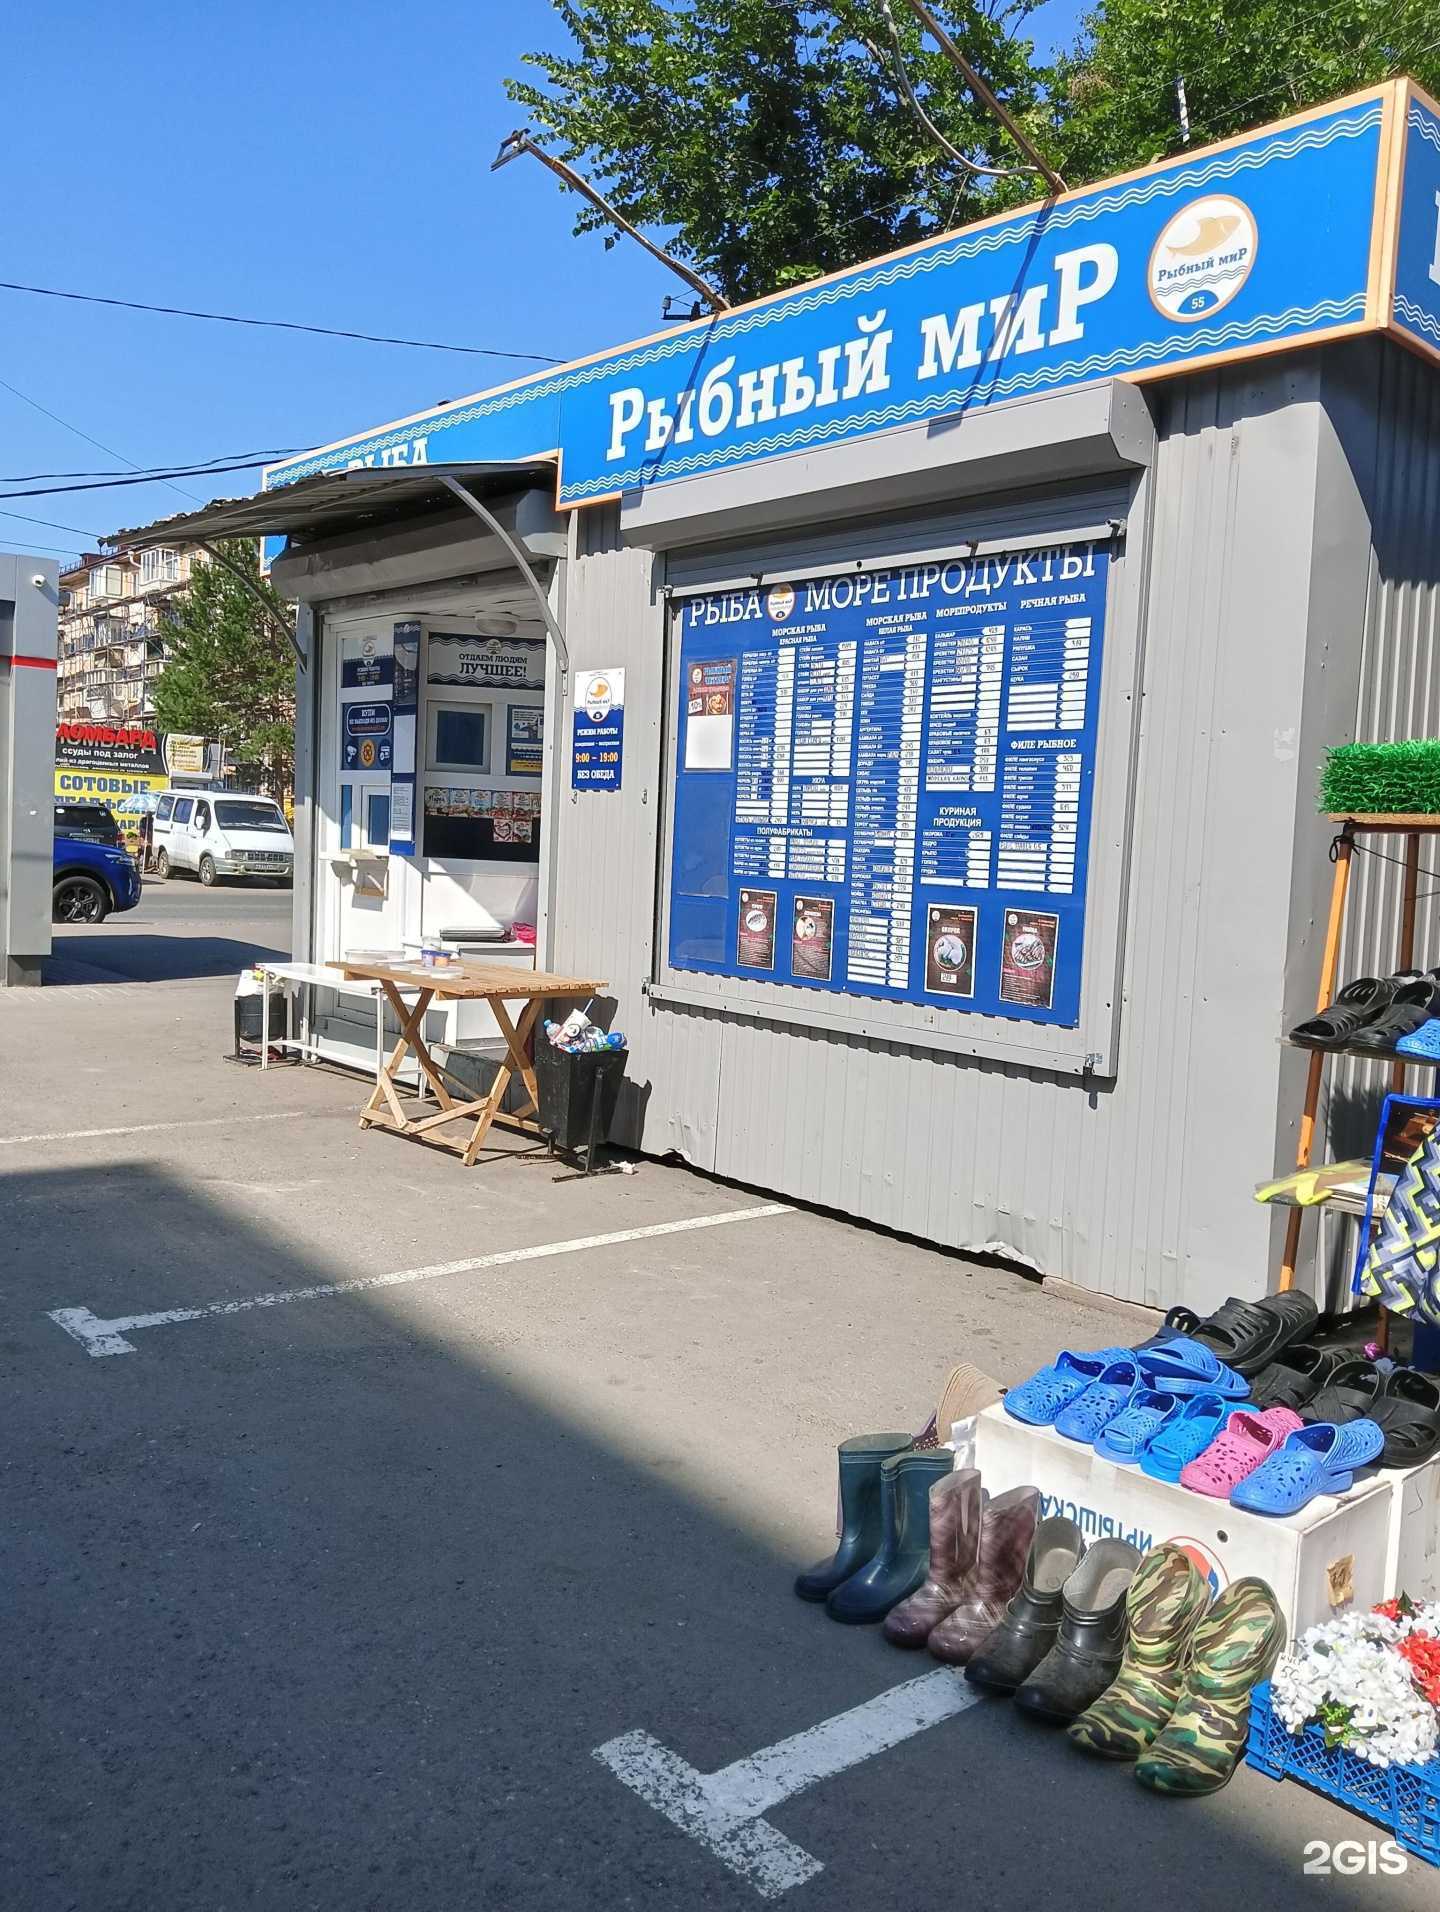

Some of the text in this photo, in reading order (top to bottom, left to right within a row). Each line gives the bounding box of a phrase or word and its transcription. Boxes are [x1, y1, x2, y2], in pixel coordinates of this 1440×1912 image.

[1158, 256, 1215, 282] Рыбный
[1191, 296, 1205, 310] 55
[606, 242, 1119, 462] Рыбный миР
[689, 544, 1096, 627] РЫБА МОРЕ ПРОДУКТЫ
[1020, 593, 1086, 608] РЕЧНАЯ РЫБА
[935, 601, 1007, 618] МОРЕПРОДУКТЫ
[459, 654, 528, 664] ОТДАЕМ ЛЮДЯМ
[460, 662, 526, 678] ЛУЧШЕЕ!
[56, 723, 157, 753] ЛОМБАРД
[1010, 739, 1076, 749] ФИЛЕ РЫБНОЕ
[62, 748, 138, 760] ссуды под залог
[576, 753, 589, 763] 9:00
[600, 752, 618, 762] 19:00
[577, 770, 615, 780] БЕЗ ОБЕДА
[60, 775, 151, 794] СОТОВЫЕ
[939, 806, 976, 815] КУРИНАЯ
[933, 817, 981, 828] ПРОДУКЦИЯ
[757, 826, 812, 836] ПОЛУФАБРИКАТЫ
